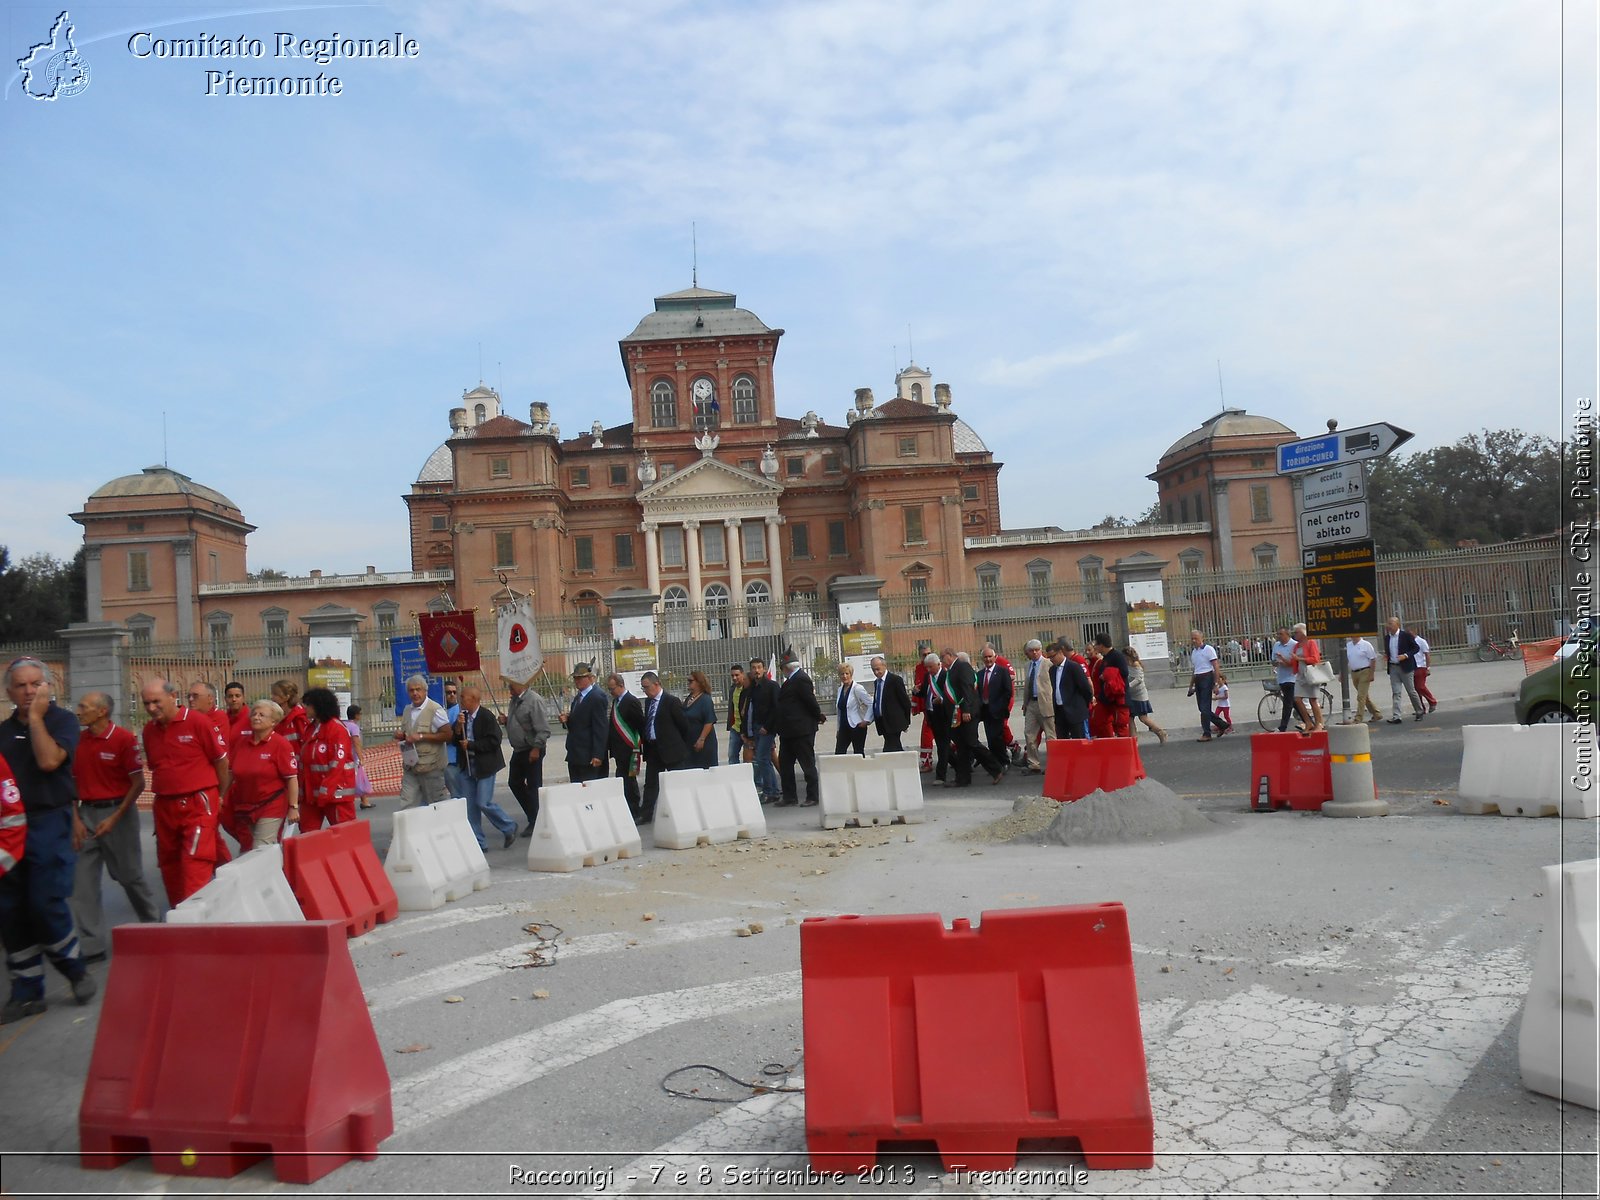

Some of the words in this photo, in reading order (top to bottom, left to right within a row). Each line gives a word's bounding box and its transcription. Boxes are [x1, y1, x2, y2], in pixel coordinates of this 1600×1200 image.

[1295, 442, 1325, 454] direzione
[1286, 451, 1334, 467] TORINO-CUNEO
[1320, 471, 1342, 483] eccetto
[1307, 515, 1322, 527] nel
[1327, 510, 1360, 523] centro
[1316, 525, 1351, 539] abitato
[1334, 547, 1371, 560] industriale
[1307, 586, 1321, 597] SIT
[1307, 609, 1327, 620] LITA
[1329, 607, 1351, 618] TUBI
[1308, 621, 1327, 631] ILVA
[515, 629, 523, 643] d
